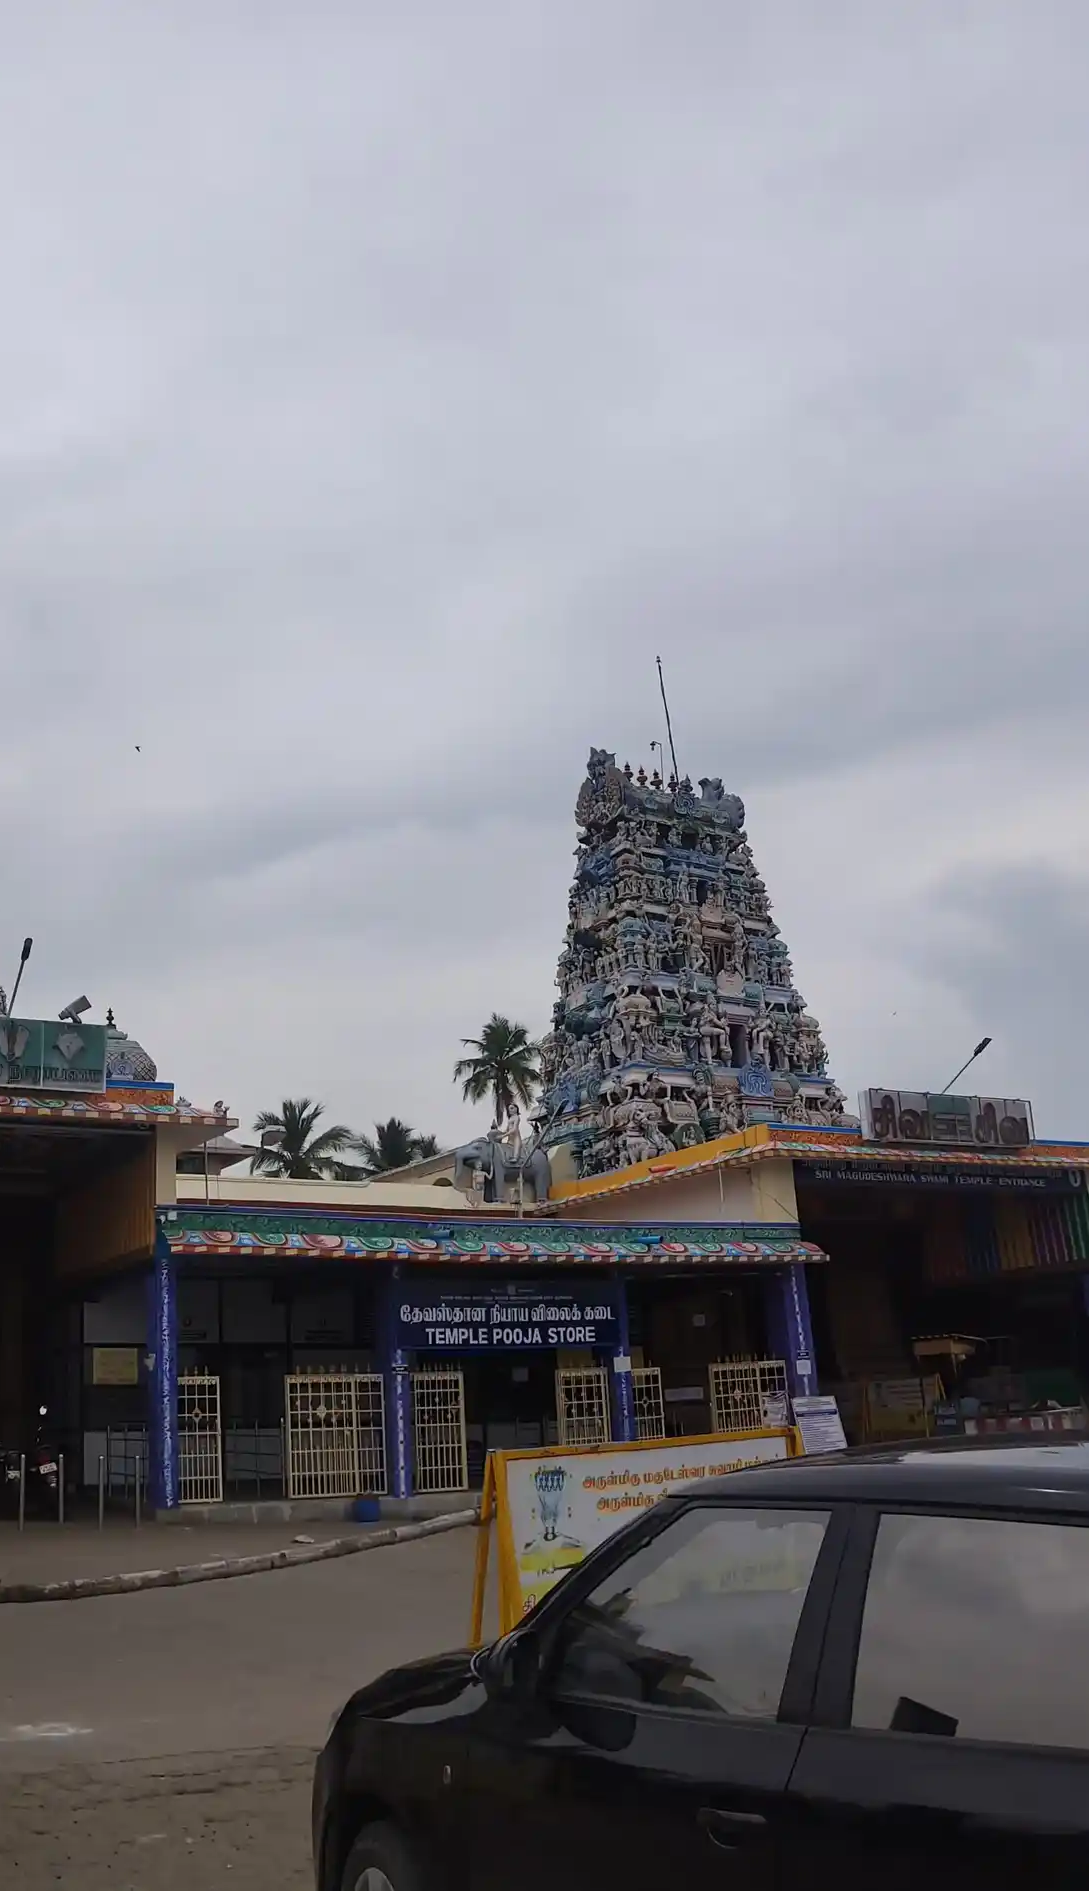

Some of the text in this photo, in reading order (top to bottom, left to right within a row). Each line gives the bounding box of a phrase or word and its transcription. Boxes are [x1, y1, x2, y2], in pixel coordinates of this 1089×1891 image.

[814, 1170, 832, 1181] SRI
[920, 1174, 949, 1185] SWAMI
[954, 1175, 993, 1186] TEMPLE
[400, 1302, 487, 1324] தேவஸ்தான
[489, 1303, 529, 1324] நியாய
[584, 1305, 617, 1321] கடை
[425, 1326, 597, 1345] TEMPLE POOJA STORE
[582, 1468, 640, 1490] அருள்மிகு
[596, 1491, 655, 1512] அருள்மிகு
